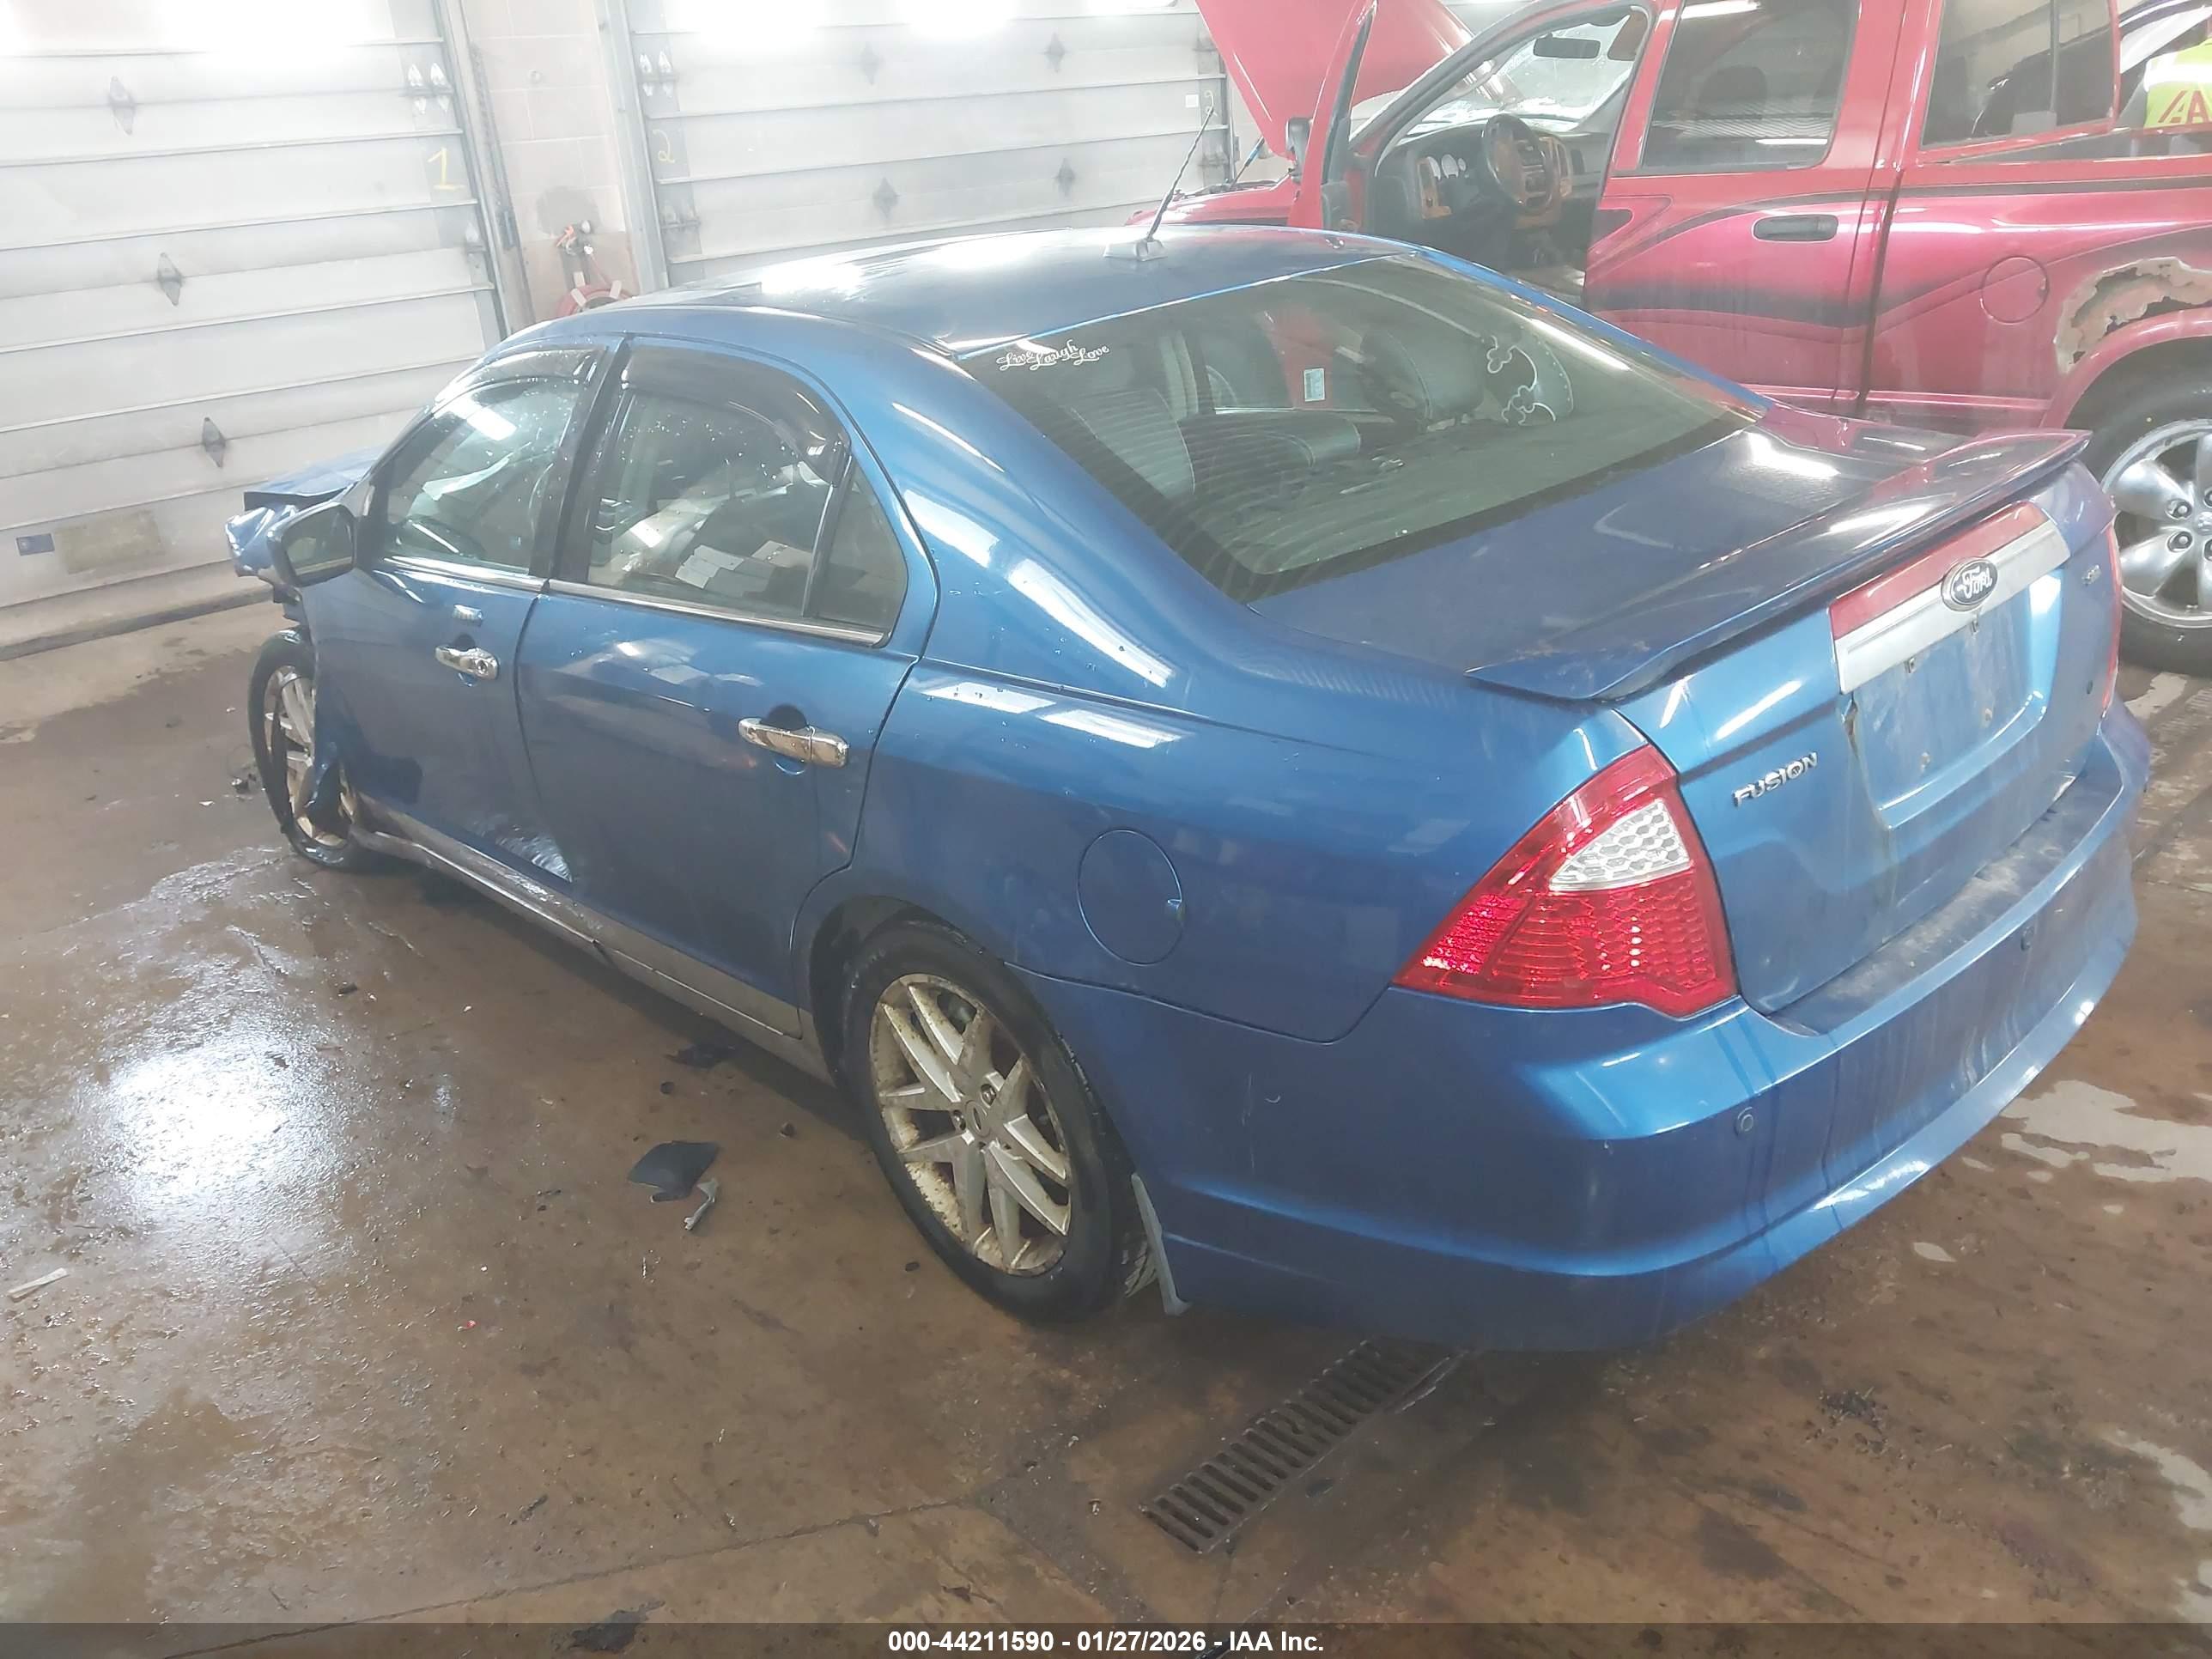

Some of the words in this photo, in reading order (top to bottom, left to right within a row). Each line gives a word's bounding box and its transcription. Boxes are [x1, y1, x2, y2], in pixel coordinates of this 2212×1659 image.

[653, 129, 675, 164] 2
[427, 146, 466, 190] 1
[996, 352, 1034, 371] Live
[1029, 339, 1079, 371] Laugh
[1070, 345, 1110, 366] Love
[1956, 565, 1993, 599] Ford
[1732, 751, 1818, 807] FUSION
